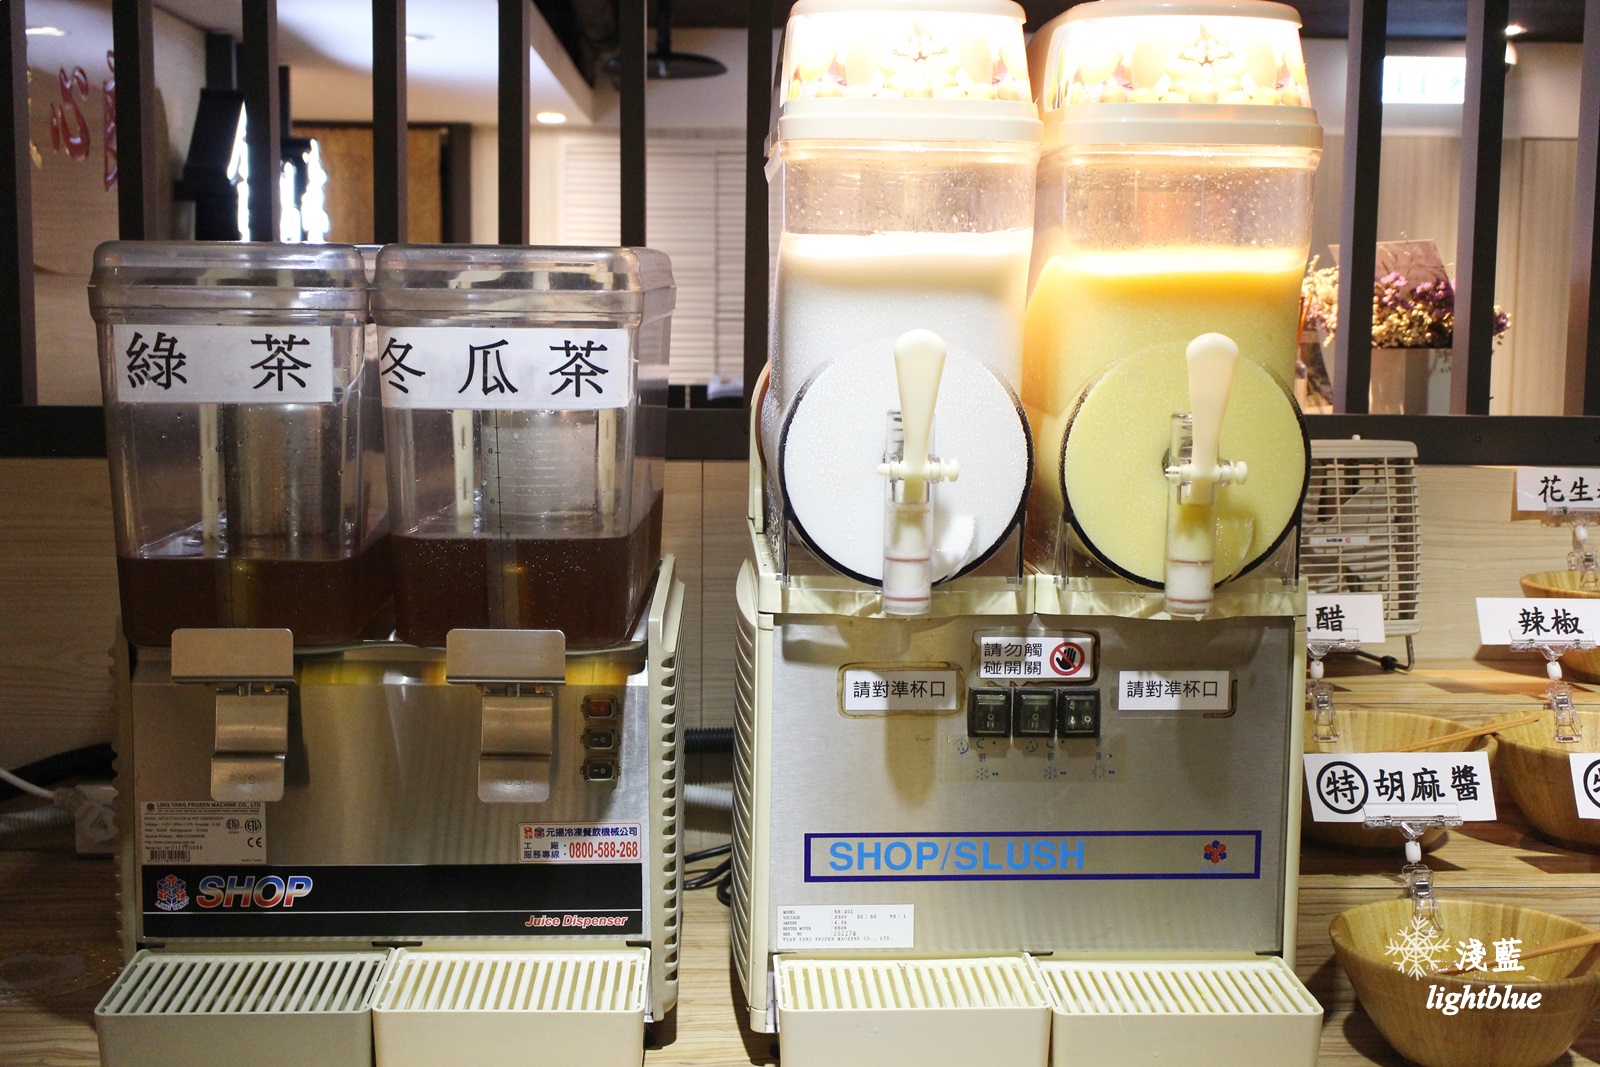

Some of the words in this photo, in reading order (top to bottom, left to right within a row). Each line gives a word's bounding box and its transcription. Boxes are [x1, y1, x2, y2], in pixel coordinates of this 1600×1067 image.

[125, 331, 312, 391] 綠茶
[380, 337, 610, 398] 冬瓜茶
[1537, 474, 1600, 503] 花生
[1517, 606, 1585, 637] 辣椒
[983, 642, 1044, 658] 請勿觸
[983, 660, 1042, 676] 碰開關
[852, 680, 946, 699] 請對準杯口
[1126, 680, 1218, 699] 請對準杯口
[1321, 766, 1363, 809] 特
[1373, 764, 1480, 802] 胡麻醬
[568, 841, 638, 858] 0800-588-268
[828, 840, 1086, 872] SHOP/SLUSH
[196, 874, 313, 909] SHOP
[525, 914, 560, 926] Juice
[562, 914, 628, 929] Dispenser
